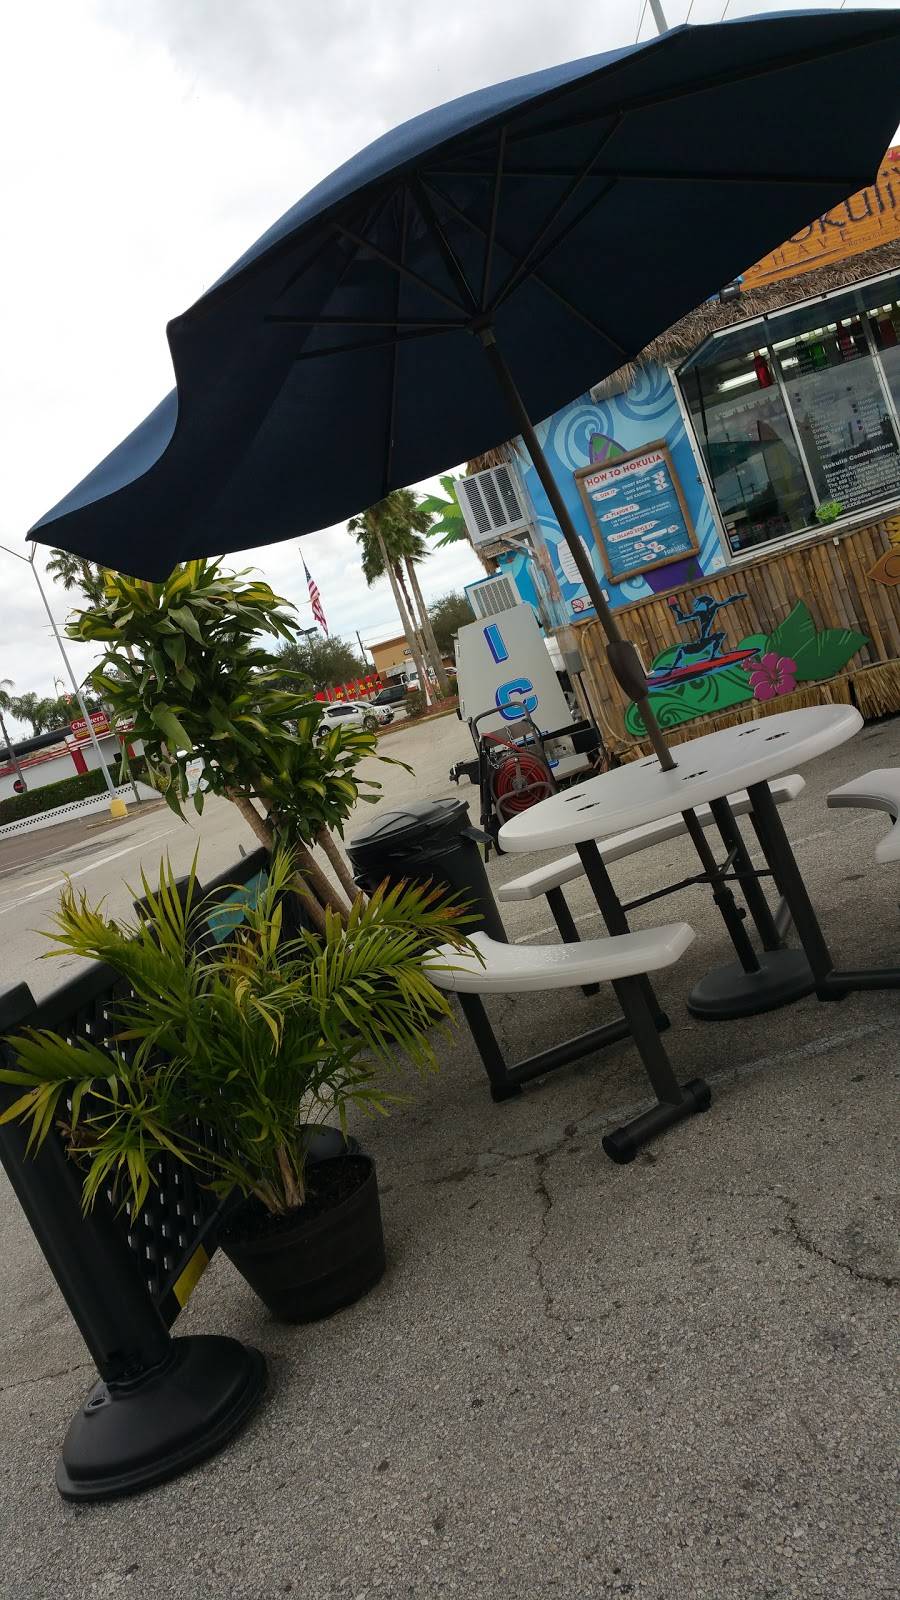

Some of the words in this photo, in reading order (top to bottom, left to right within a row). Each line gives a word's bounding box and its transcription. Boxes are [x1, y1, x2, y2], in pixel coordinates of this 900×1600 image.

[823, 457, 848, 470] Hokulia
[849, 442, 893, 461] Combinations
[587, 474, 607, 487] HOW
[610, 467, 621, 478] TO
[624, 454, 663, 473] HOKULIA
[72, 715, 104, 730] Cheers
